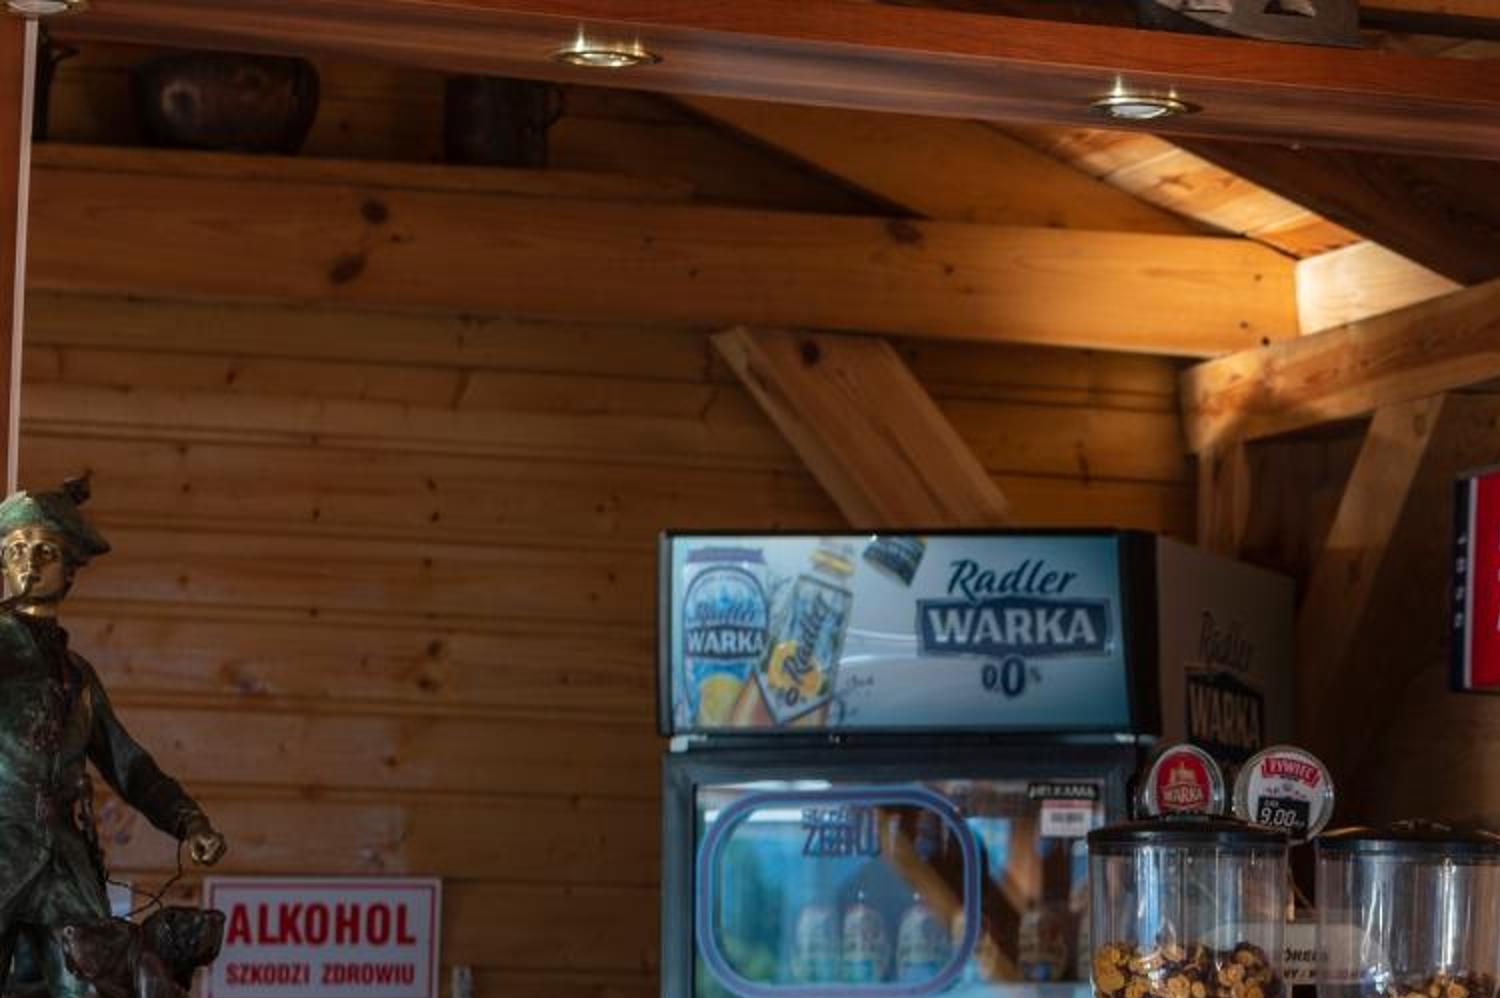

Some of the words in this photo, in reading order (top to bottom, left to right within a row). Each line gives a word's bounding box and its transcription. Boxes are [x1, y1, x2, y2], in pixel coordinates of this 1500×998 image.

[948, 559, 1077, 605] Radler
[687, 629, 766, 654] WARKA
[928, 608, 1097, 644] WARKA
[226, 903, 416, 946] ALKOHOL
[225, 962, 310, 985] SZKODZI
[321, 962, 415, 985] ZDROWIU
